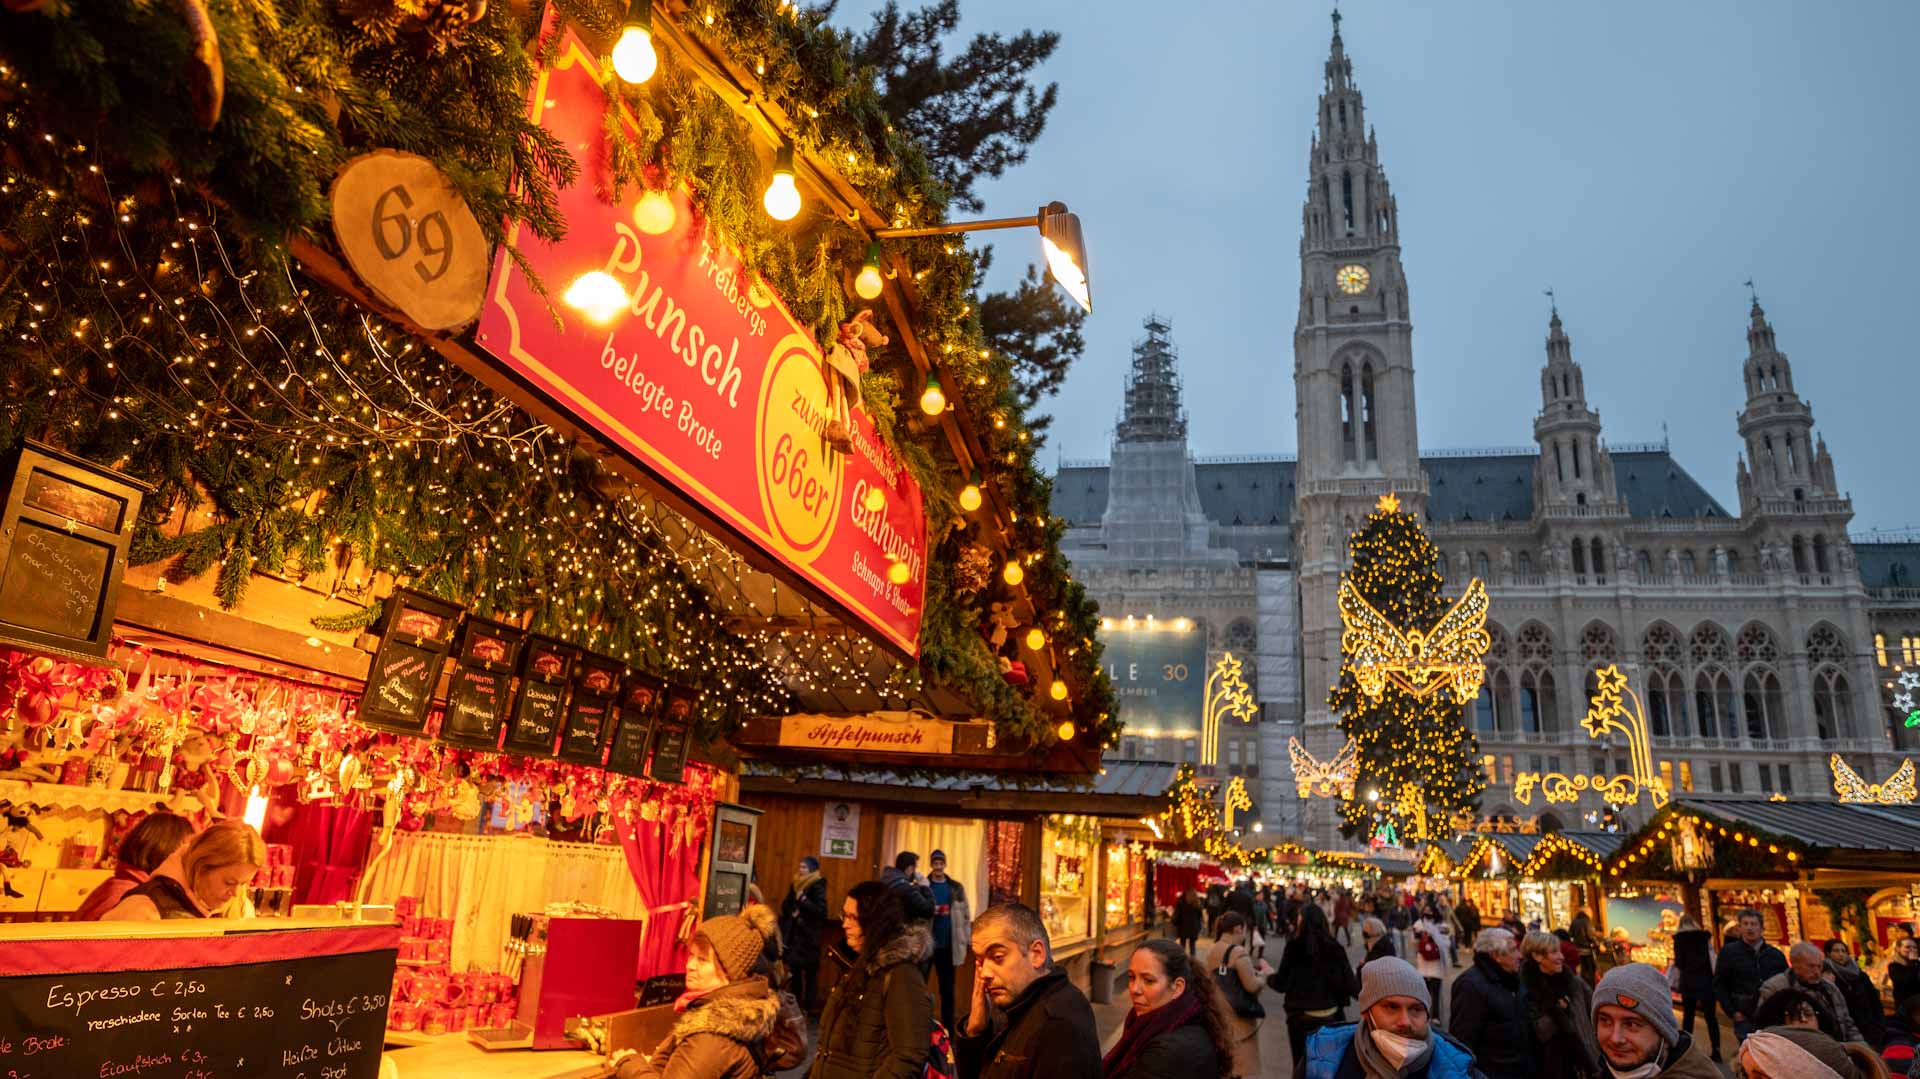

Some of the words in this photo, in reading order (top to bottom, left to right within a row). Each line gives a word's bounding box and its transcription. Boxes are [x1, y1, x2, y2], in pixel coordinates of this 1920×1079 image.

[372, 184, 453, 284] 69
[698, 240, 767, 336] Freibergs
[606, 222, 742, 408] Punsch
[600, 331, 674, 418] belegte
[678, 400, 723, 460] Brote
[791, 388, 827, 437] zum
[771, 432, 829, 519] 66er
[852, 550, 885, 598] Schnaps
[885, 580, 893, 601] &
[1109, 663, 1138, 681] LE
[1162, 663, 1189, 681] 30
[1117, 687, 1158, 697] EMBER
[808, 723, 924, 747] Apfelpunsch
[46, 984, 141, 1016] Espresso
[150, 981, 166, 997] €
[174, 981, 206, 998] 2,50
[88, 1010, 161, 1031] verschiedene
[171, 1007, 207, 1022] Sorten
[214, 1004, 230, 1019] Tee
[238, 1007, 246, 1018] €
[253, 1006, 275, 1019] 2,50
[300, 998, 344, 1021] Shots
[362, 994, 386, 1012] 3,50
[282, 1045, 318, 1067] Heiße
